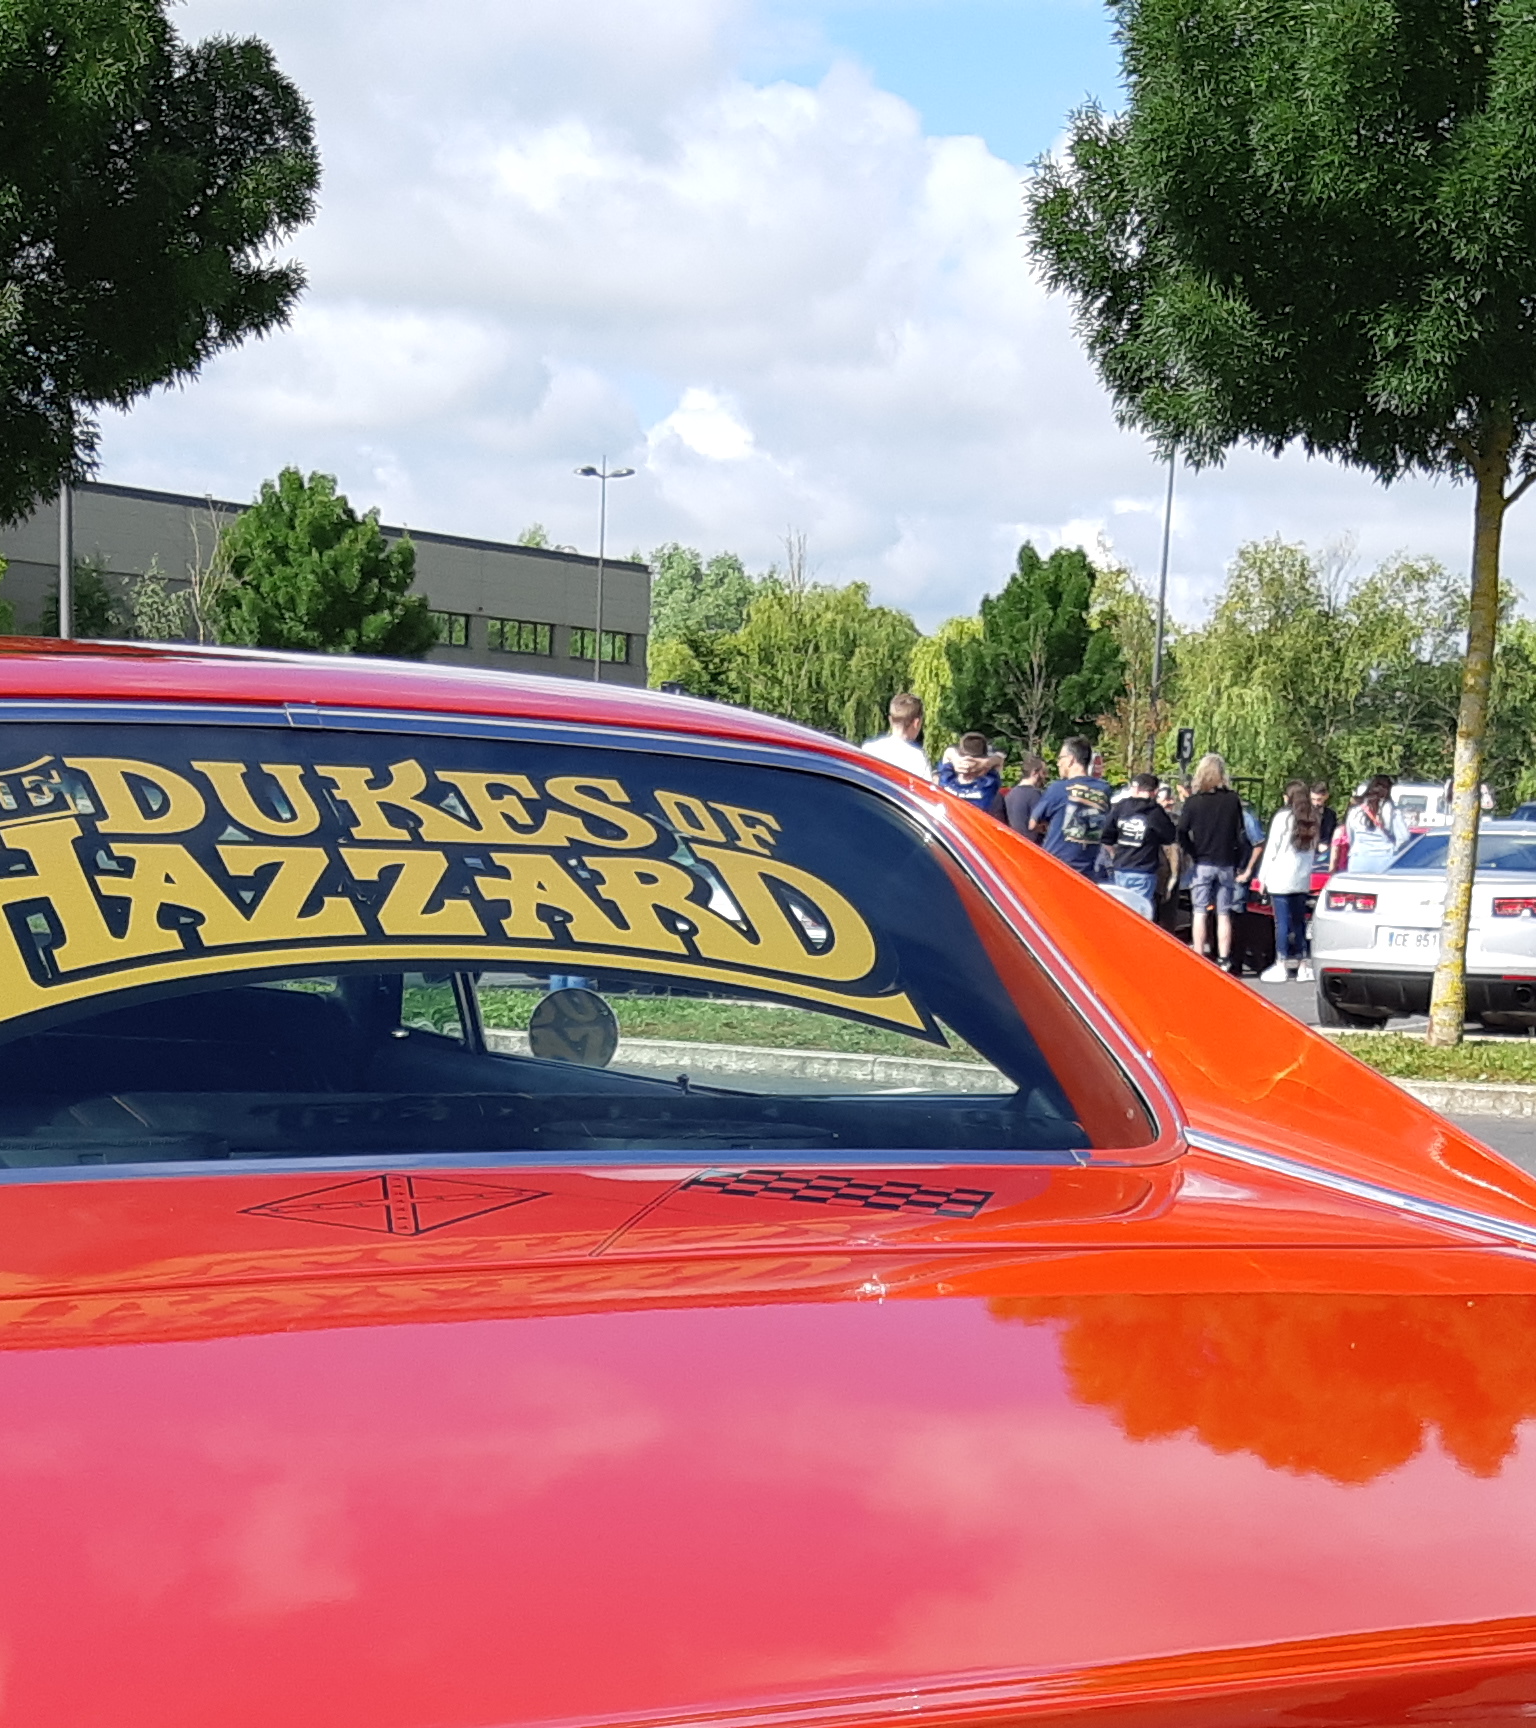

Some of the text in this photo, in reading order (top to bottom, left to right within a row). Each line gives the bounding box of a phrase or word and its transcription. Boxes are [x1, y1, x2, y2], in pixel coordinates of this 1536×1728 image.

[1182, 732, 1192, 759] 5
[62, 757, 658, 849] DUKES
[654, 790, 783, 856] OF
